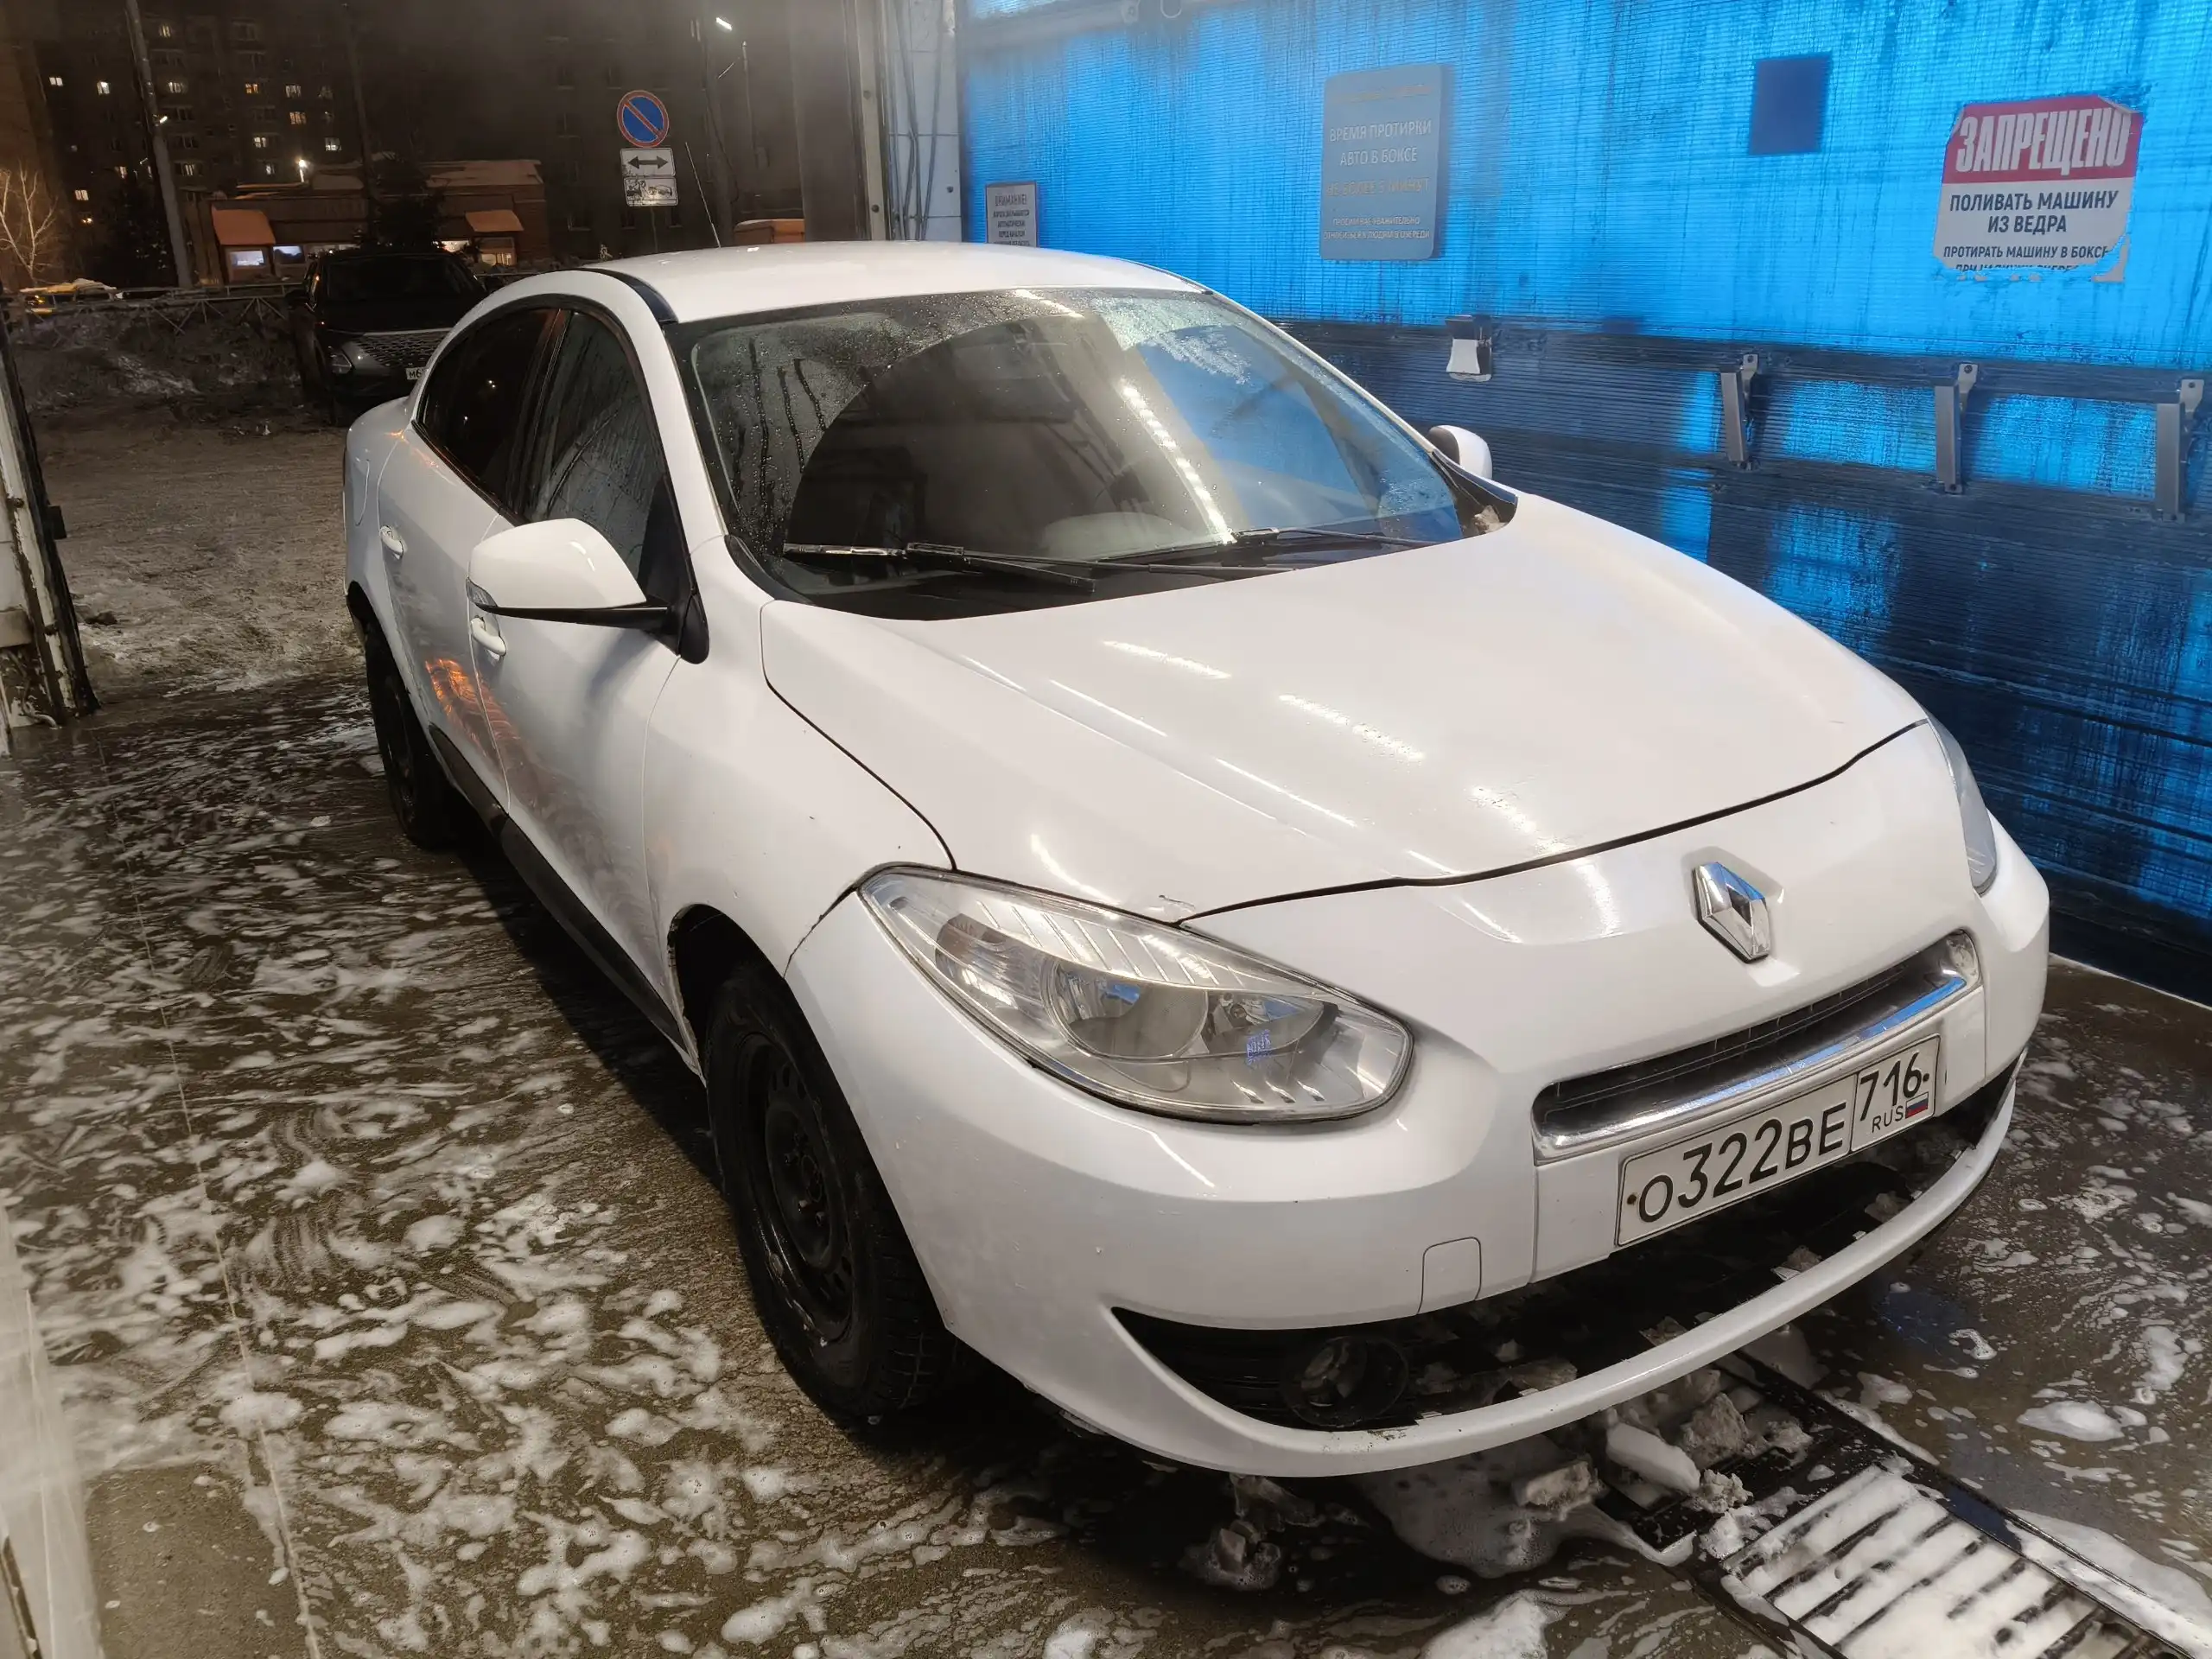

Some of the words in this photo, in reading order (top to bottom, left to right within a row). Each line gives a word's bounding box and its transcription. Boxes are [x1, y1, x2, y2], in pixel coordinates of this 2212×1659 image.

[1330, 123, 1366, 142] ВРЕМЯ
[1370, 119, 1431, 138] ПРОТИРКИ
[1955, 107, 2132, 175] ЗАПРЕЩЕНО
[1340, 149, 1368, 166] АВТО
[1370, 149, 1379, 164] В
[1382, 147, 1418, 163] БОКСЕ
[1950, 194, 2032, 211] ПОЛИВАТЬ
[2037, 190, 2119, 209] МАШИНУ
[1987, 216, 2009, 232] ИЗ
[2014, 215, 2067, 235] ВЕДРА
[1944, 246, 2003, 258] ПРОТИРАТЬ
[2005, 246, 2058, 258] МАШИНУ
[2060, 246, 2069, 258] В
[1872, 1105, 1904, 1134] RUS
[1638, 1101, 1847, 1223] О322ВЕ
[1859, 1050, 1923, 1122] 716
